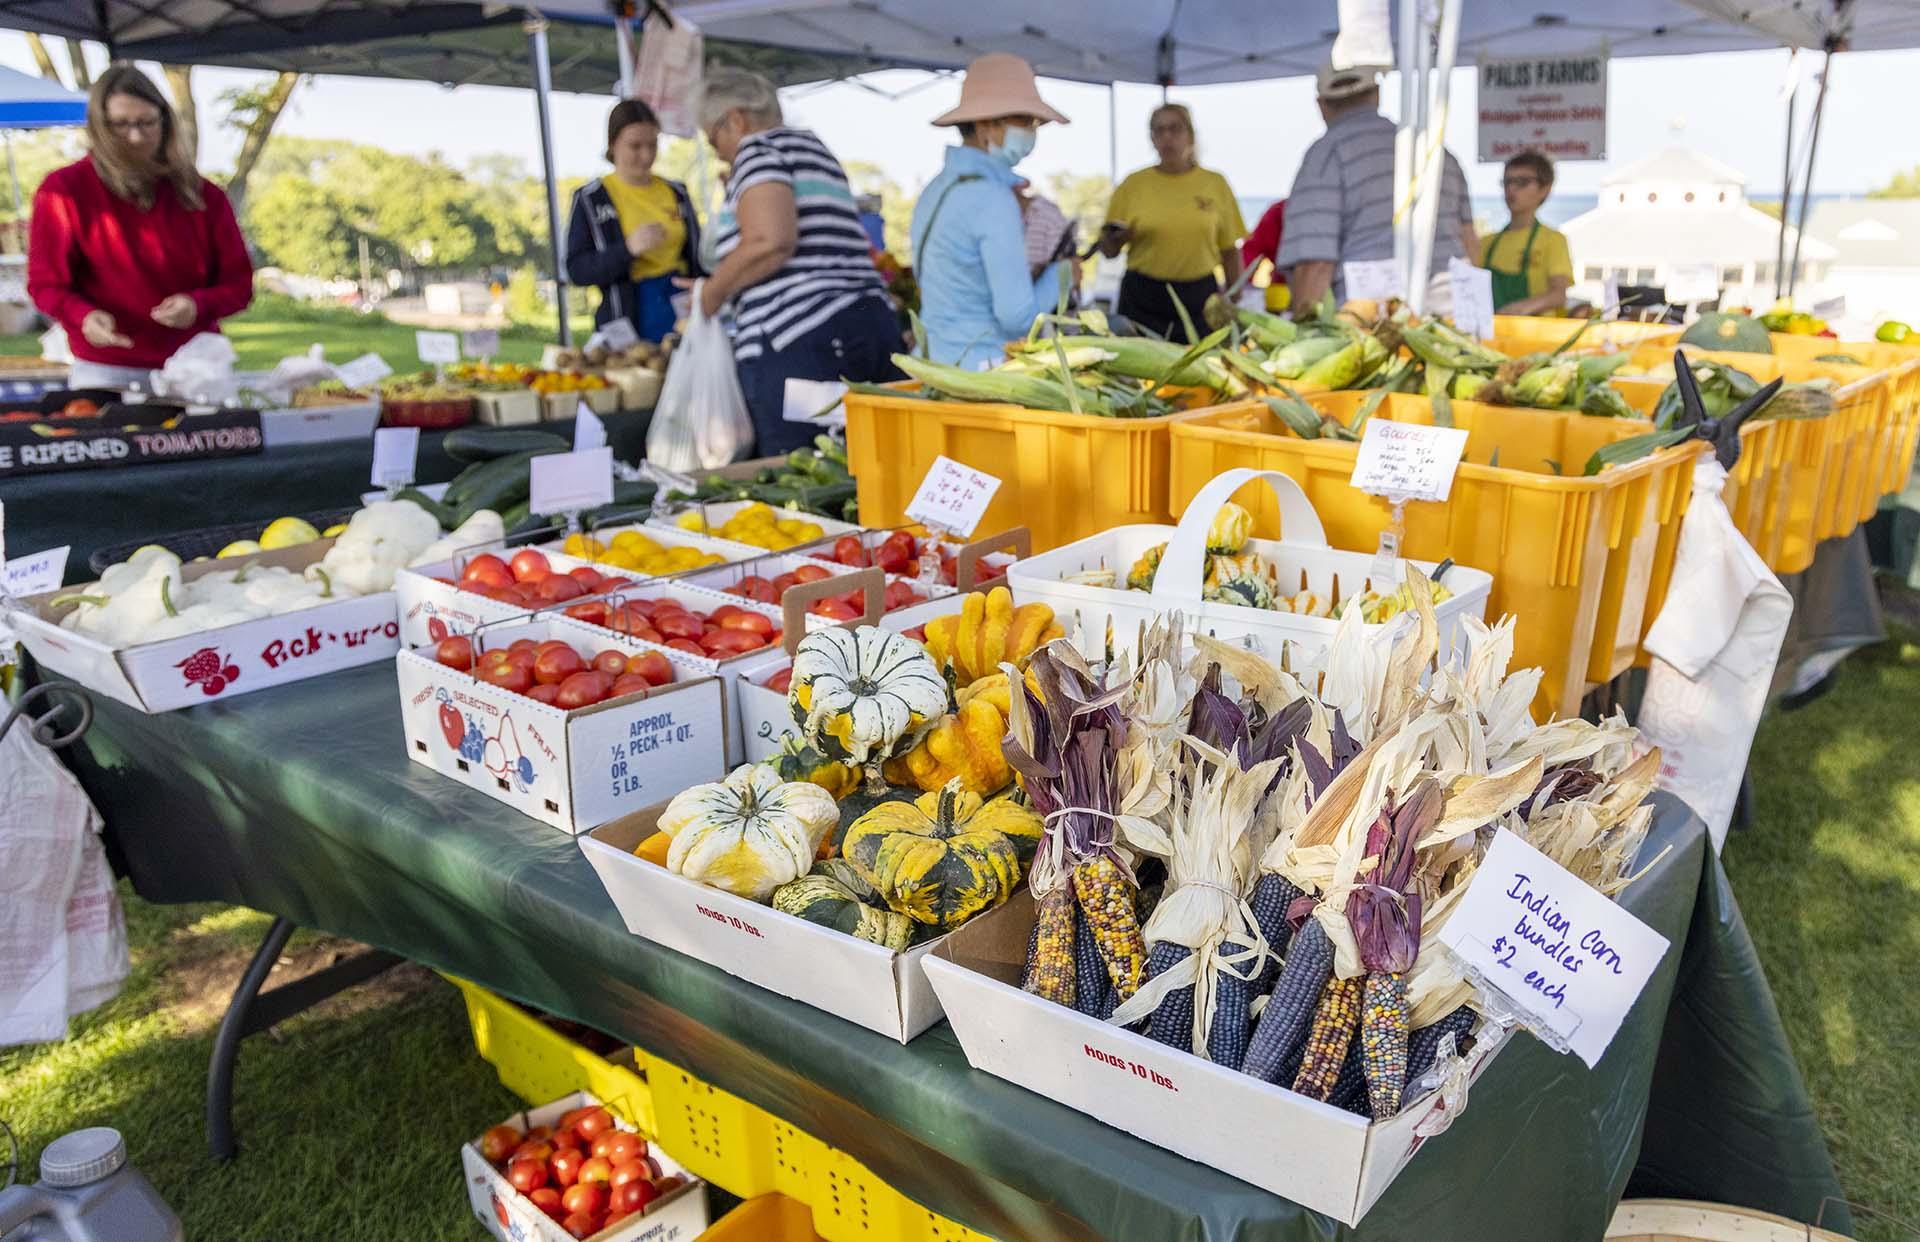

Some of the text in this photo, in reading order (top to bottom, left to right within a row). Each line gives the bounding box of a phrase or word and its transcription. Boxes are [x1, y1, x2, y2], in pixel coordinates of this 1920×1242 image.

[1536, 58, 1601, 85] FARMS
[19, 437, 130, 467] RIPENED
[132, 426, 262, 456] TOMATOES
[411, 683, 435, 707] FRESH
[453, 690, 499, 717] SELECTED
[630, 711, 676, 738] APPROX.
[676, 723, 695, 742] QT.
[527, 722, 558, 763] FRUIT
[611, 761, 628, 779] OR
[612, 775, 643, 797] 5 LB.
[1506, 873, 1622, 975] Indian Corn
[1513, 914, 1584, 973] bundles
[1492, 936, 1567, 1010] $2 each
[1127, 1061, 1147, 1079] 10
[632, 1223, 667, 1242] PPROX.
